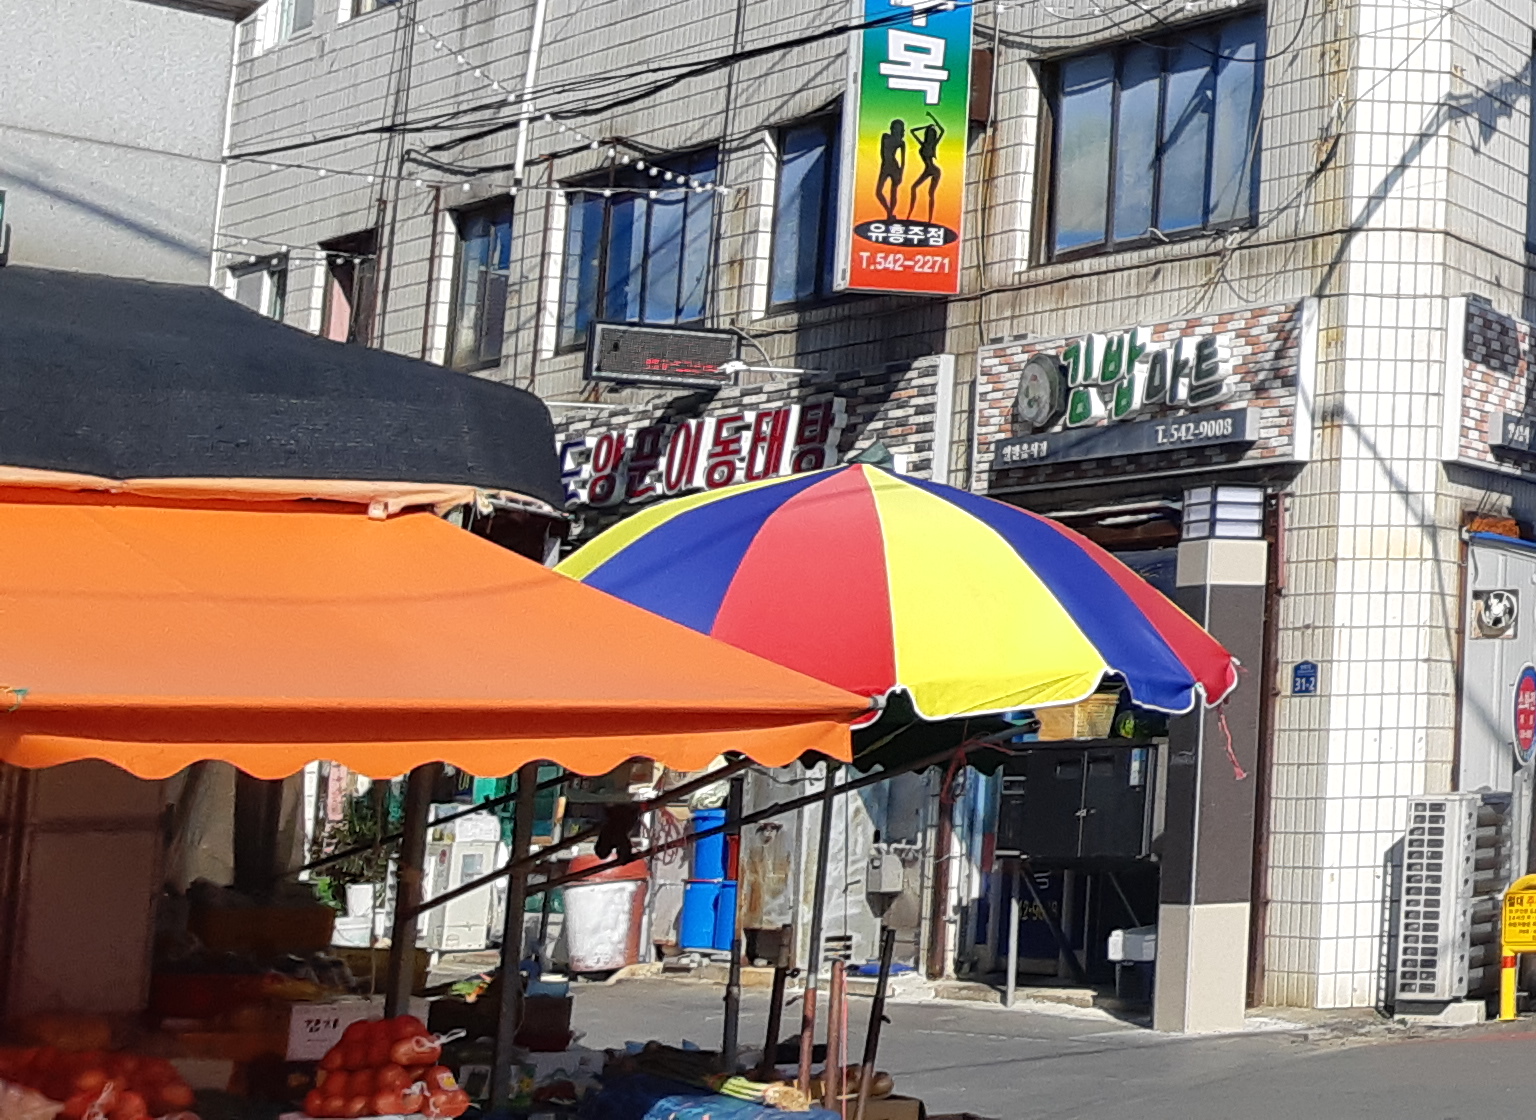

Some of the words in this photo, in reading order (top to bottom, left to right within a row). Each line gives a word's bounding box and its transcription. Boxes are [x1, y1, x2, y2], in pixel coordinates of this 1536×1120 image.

[867, 223, 945, 246] 유흥주점
[860, 252, 950, 274] T.542-2271
[1062, 329, 1226, 426] 김밥마트
[1156, 418, 1233, 445] T.542-9008
[587, 401, 834, 505] 양푼이동태탕
[1295, 677, 1316, 691] 31-2
